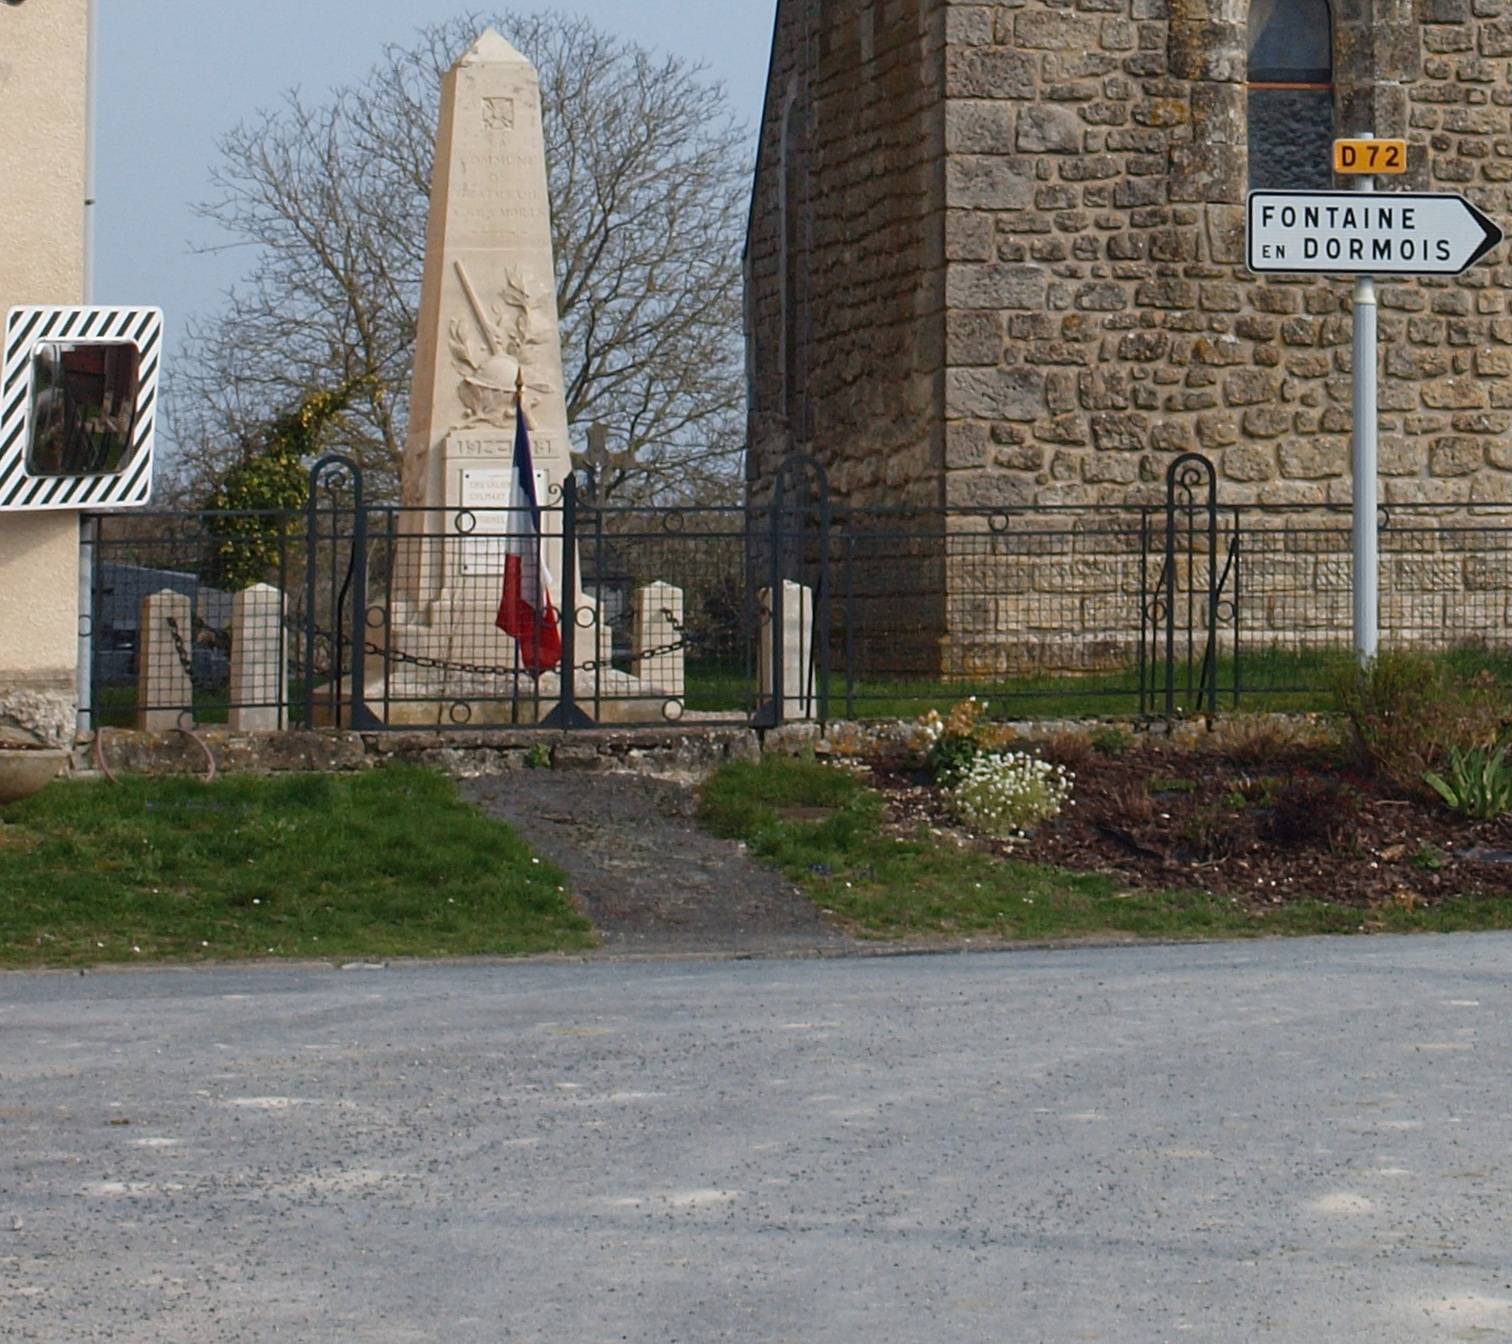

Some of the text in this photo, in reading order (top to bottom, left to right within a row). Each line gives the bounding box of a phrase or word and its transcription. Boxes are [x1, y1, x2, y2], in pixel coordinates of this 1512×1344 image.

[1342, 145, 1400, 167] D 72
[1262, 205, 1416, 230] FONTAINE
[1262, 237, 1451, 261] EN DORMOIS
